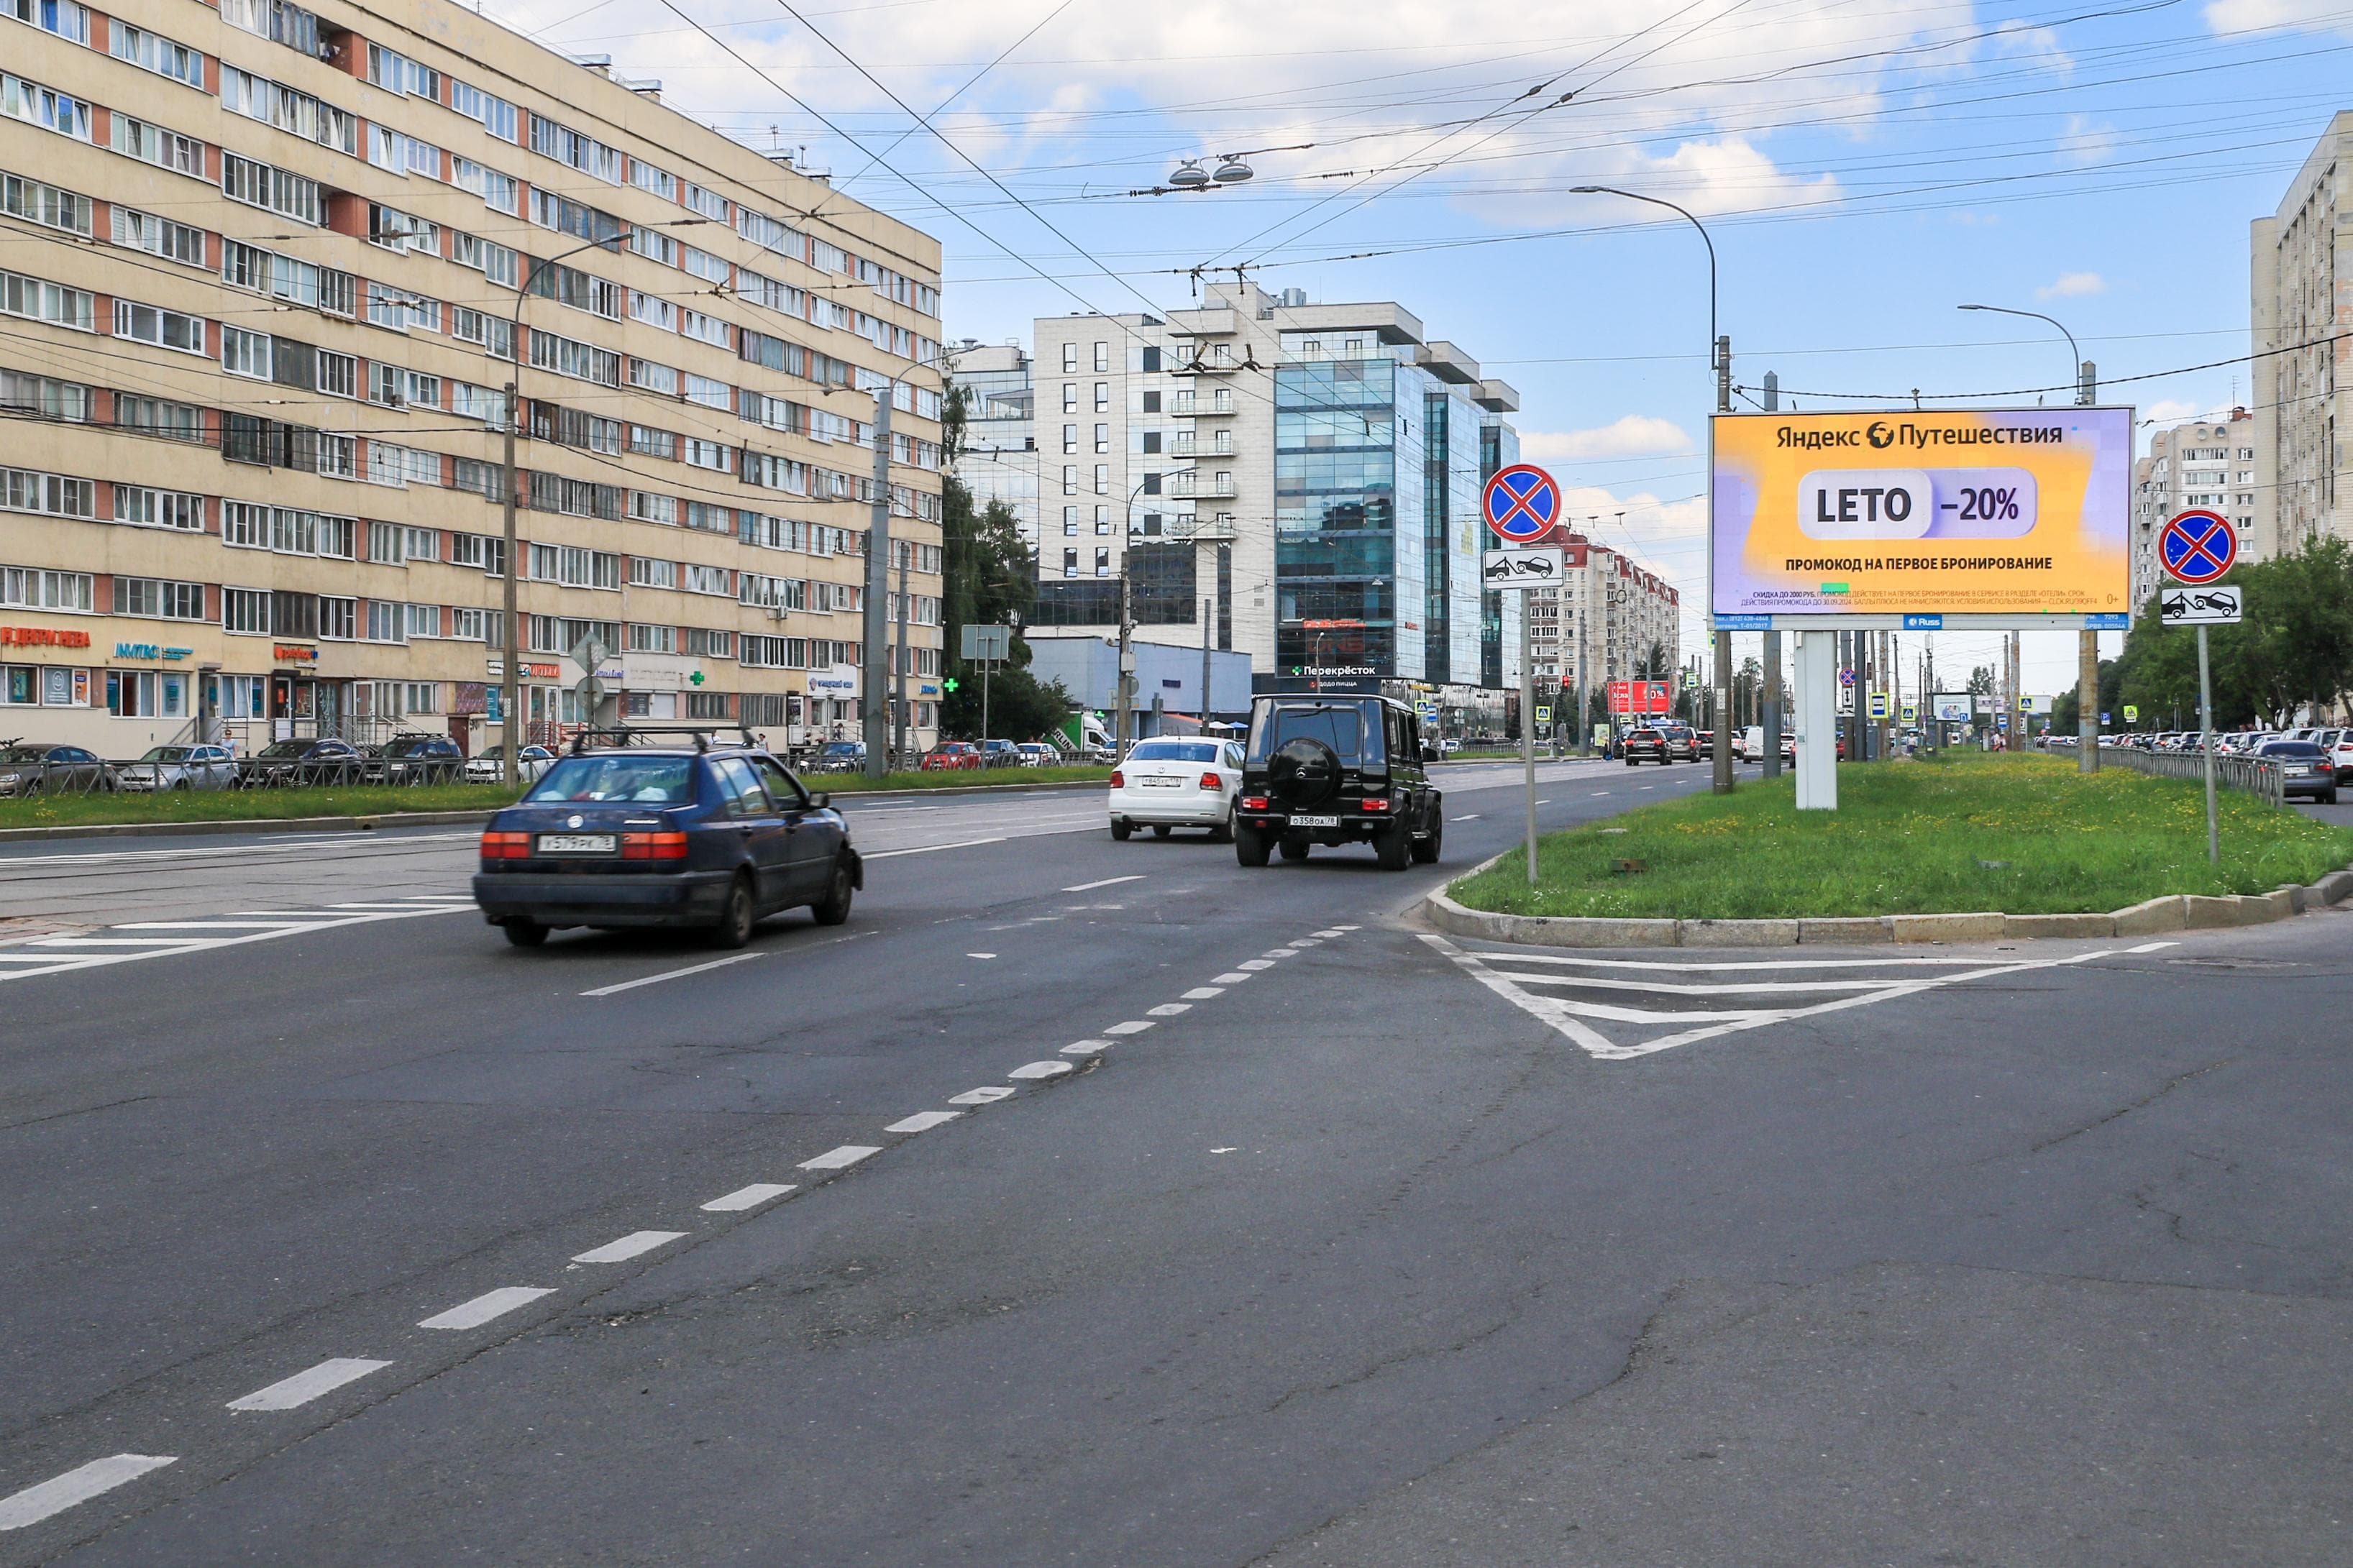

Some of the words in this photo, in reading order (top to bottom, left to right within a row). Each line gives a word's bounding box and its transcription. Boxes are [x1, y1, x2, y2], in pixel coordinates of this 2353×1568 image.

[1777, 426, 1860, 450] Яндекс
[1899, 423, 2062, 449] Путешествия
[1817, 487, 1912, 523] LETO
[1786, 559, 1862, 572] ПРОМОКОД
[1865, 559, 1883, 570] НА
[1886, 558, 1938, 570] ПЕРВОЕ
[1941, 556, 2052, 569] БРОНИРОВАНИЕ
[1303, 666, 1376, 677] Перекрёсток
